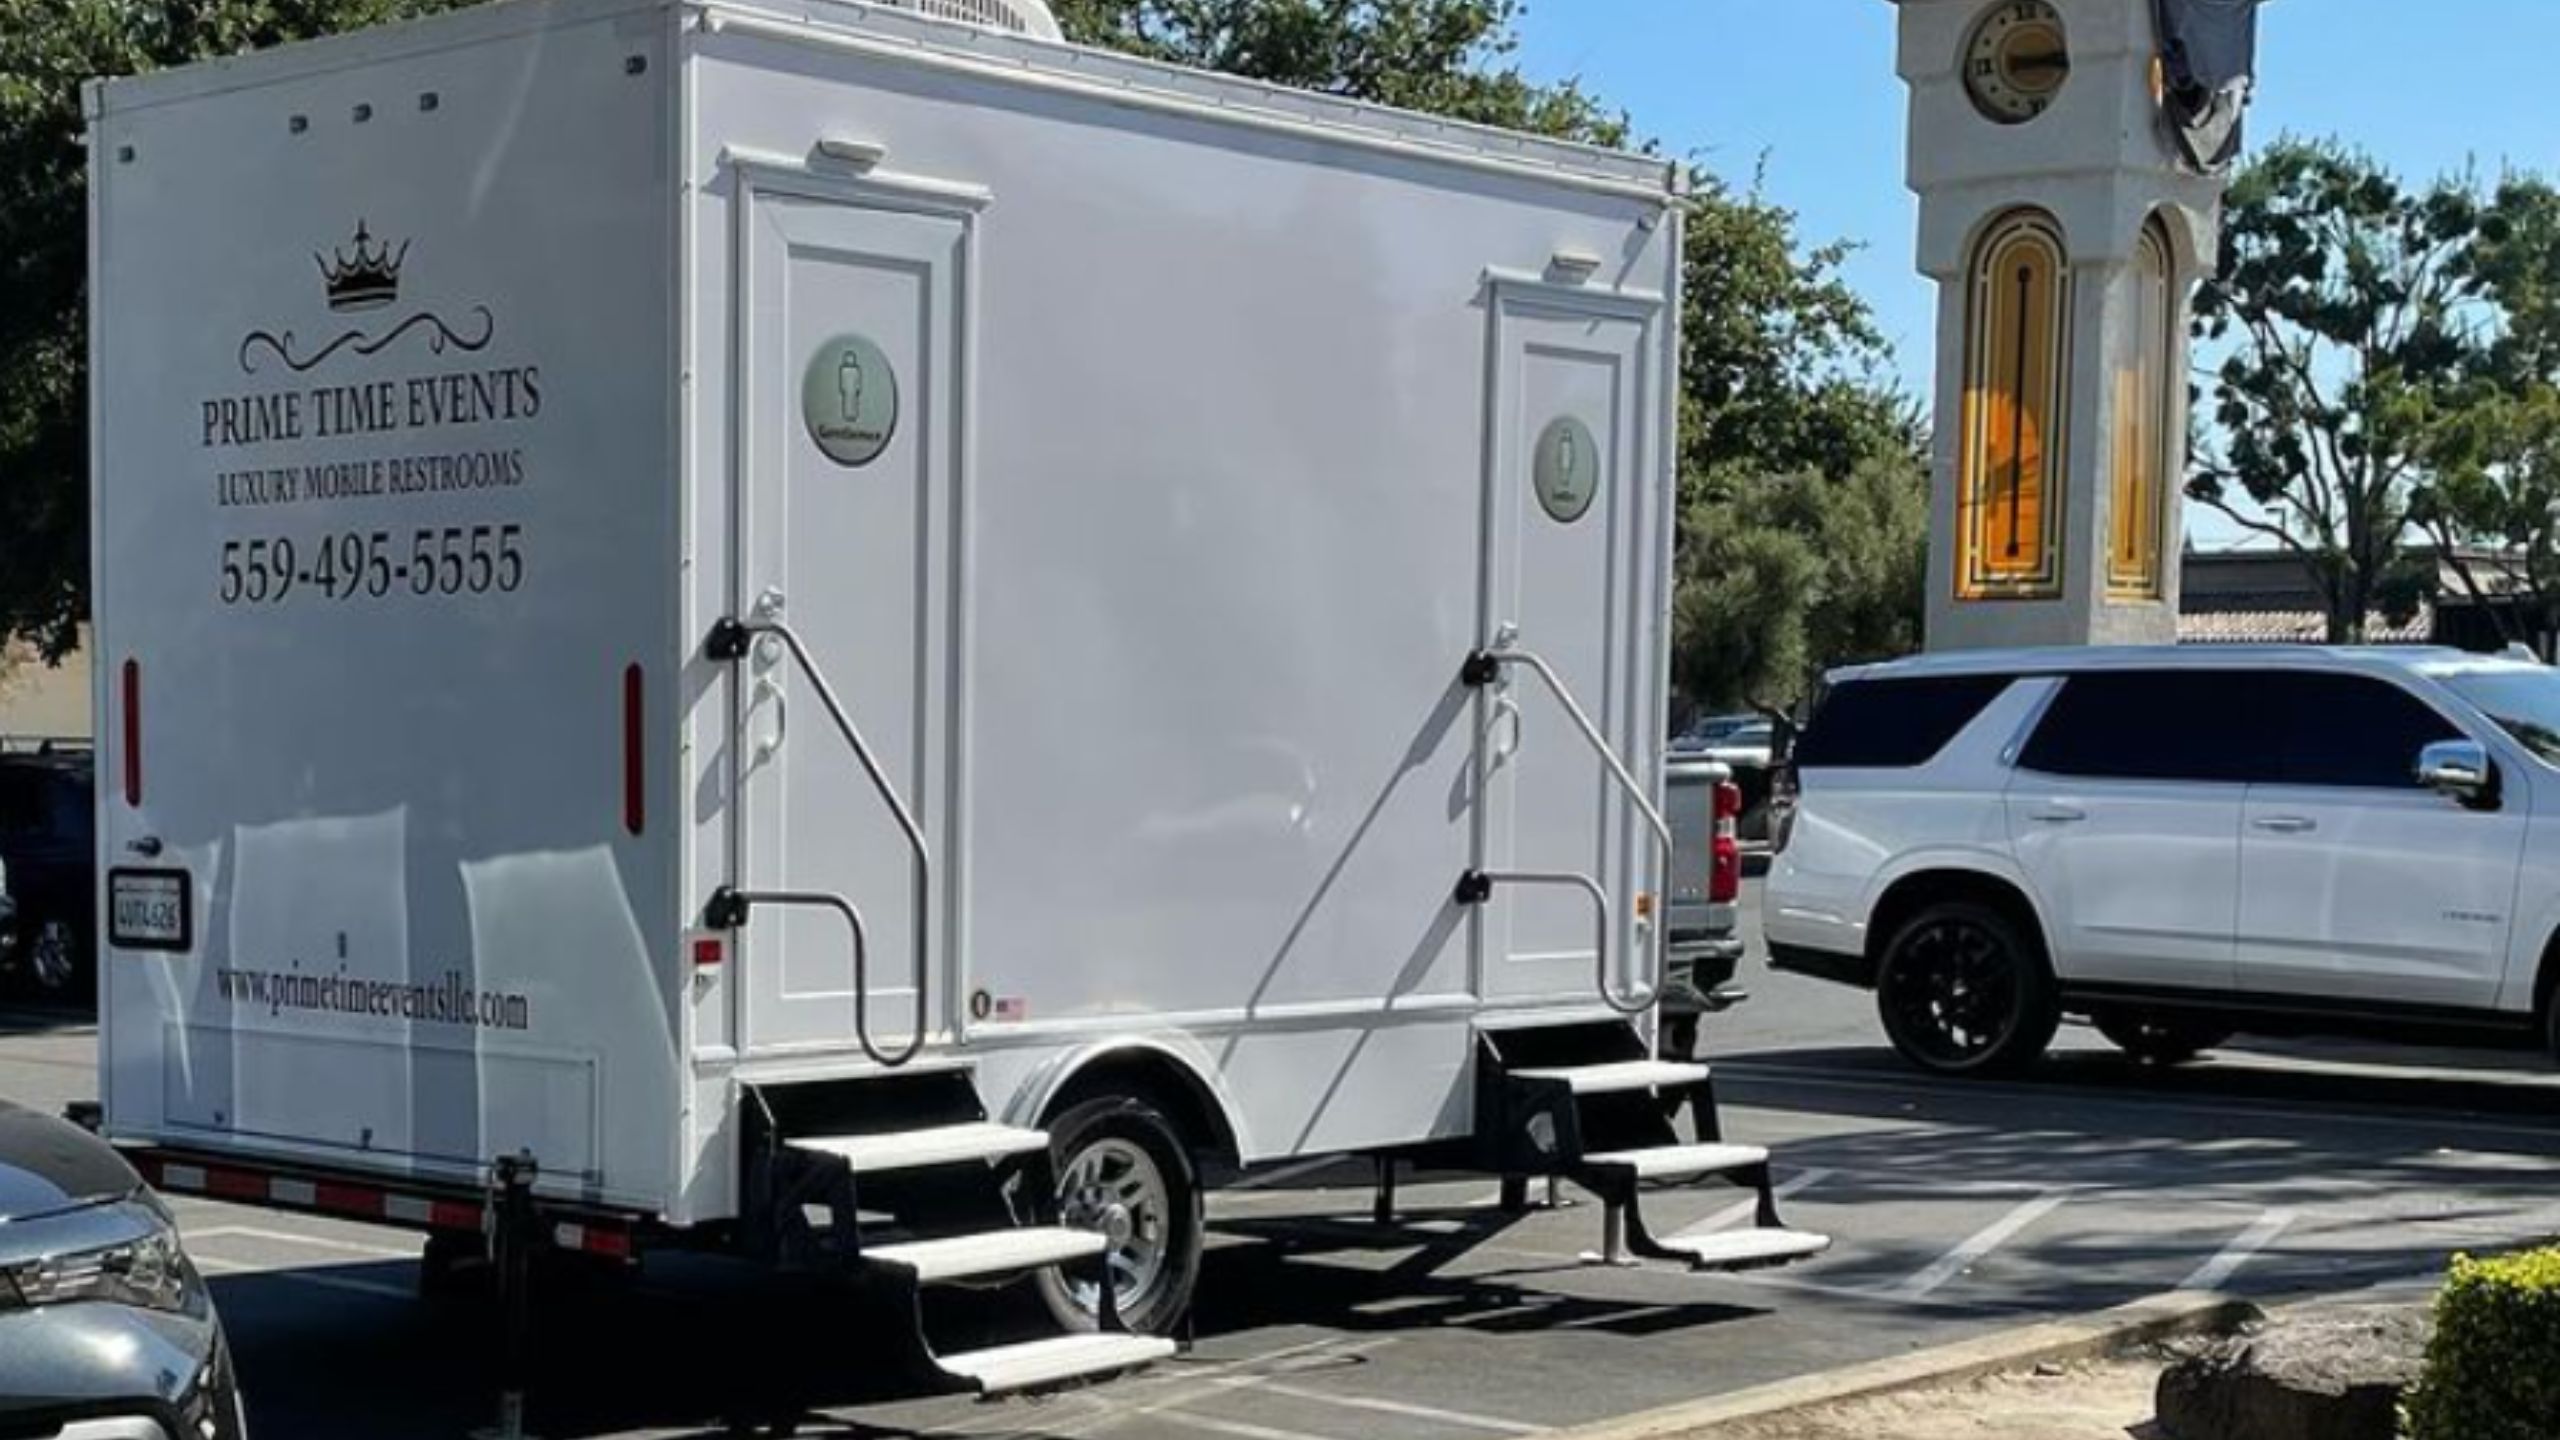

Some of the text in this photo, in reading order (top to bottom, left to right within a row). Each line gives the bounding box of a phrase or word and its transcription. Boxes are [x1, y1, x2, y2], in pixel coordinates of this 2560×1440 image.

[201, 366, 542, 447] PRIME TIME EVENTS
[217, 450, 524, 507] LUXURY MOBILE RESTROOMS
[219, 524, 523, 605] 559-495-5555
[216, 958, 529, 1031] www.primetimeeventsllc.com
